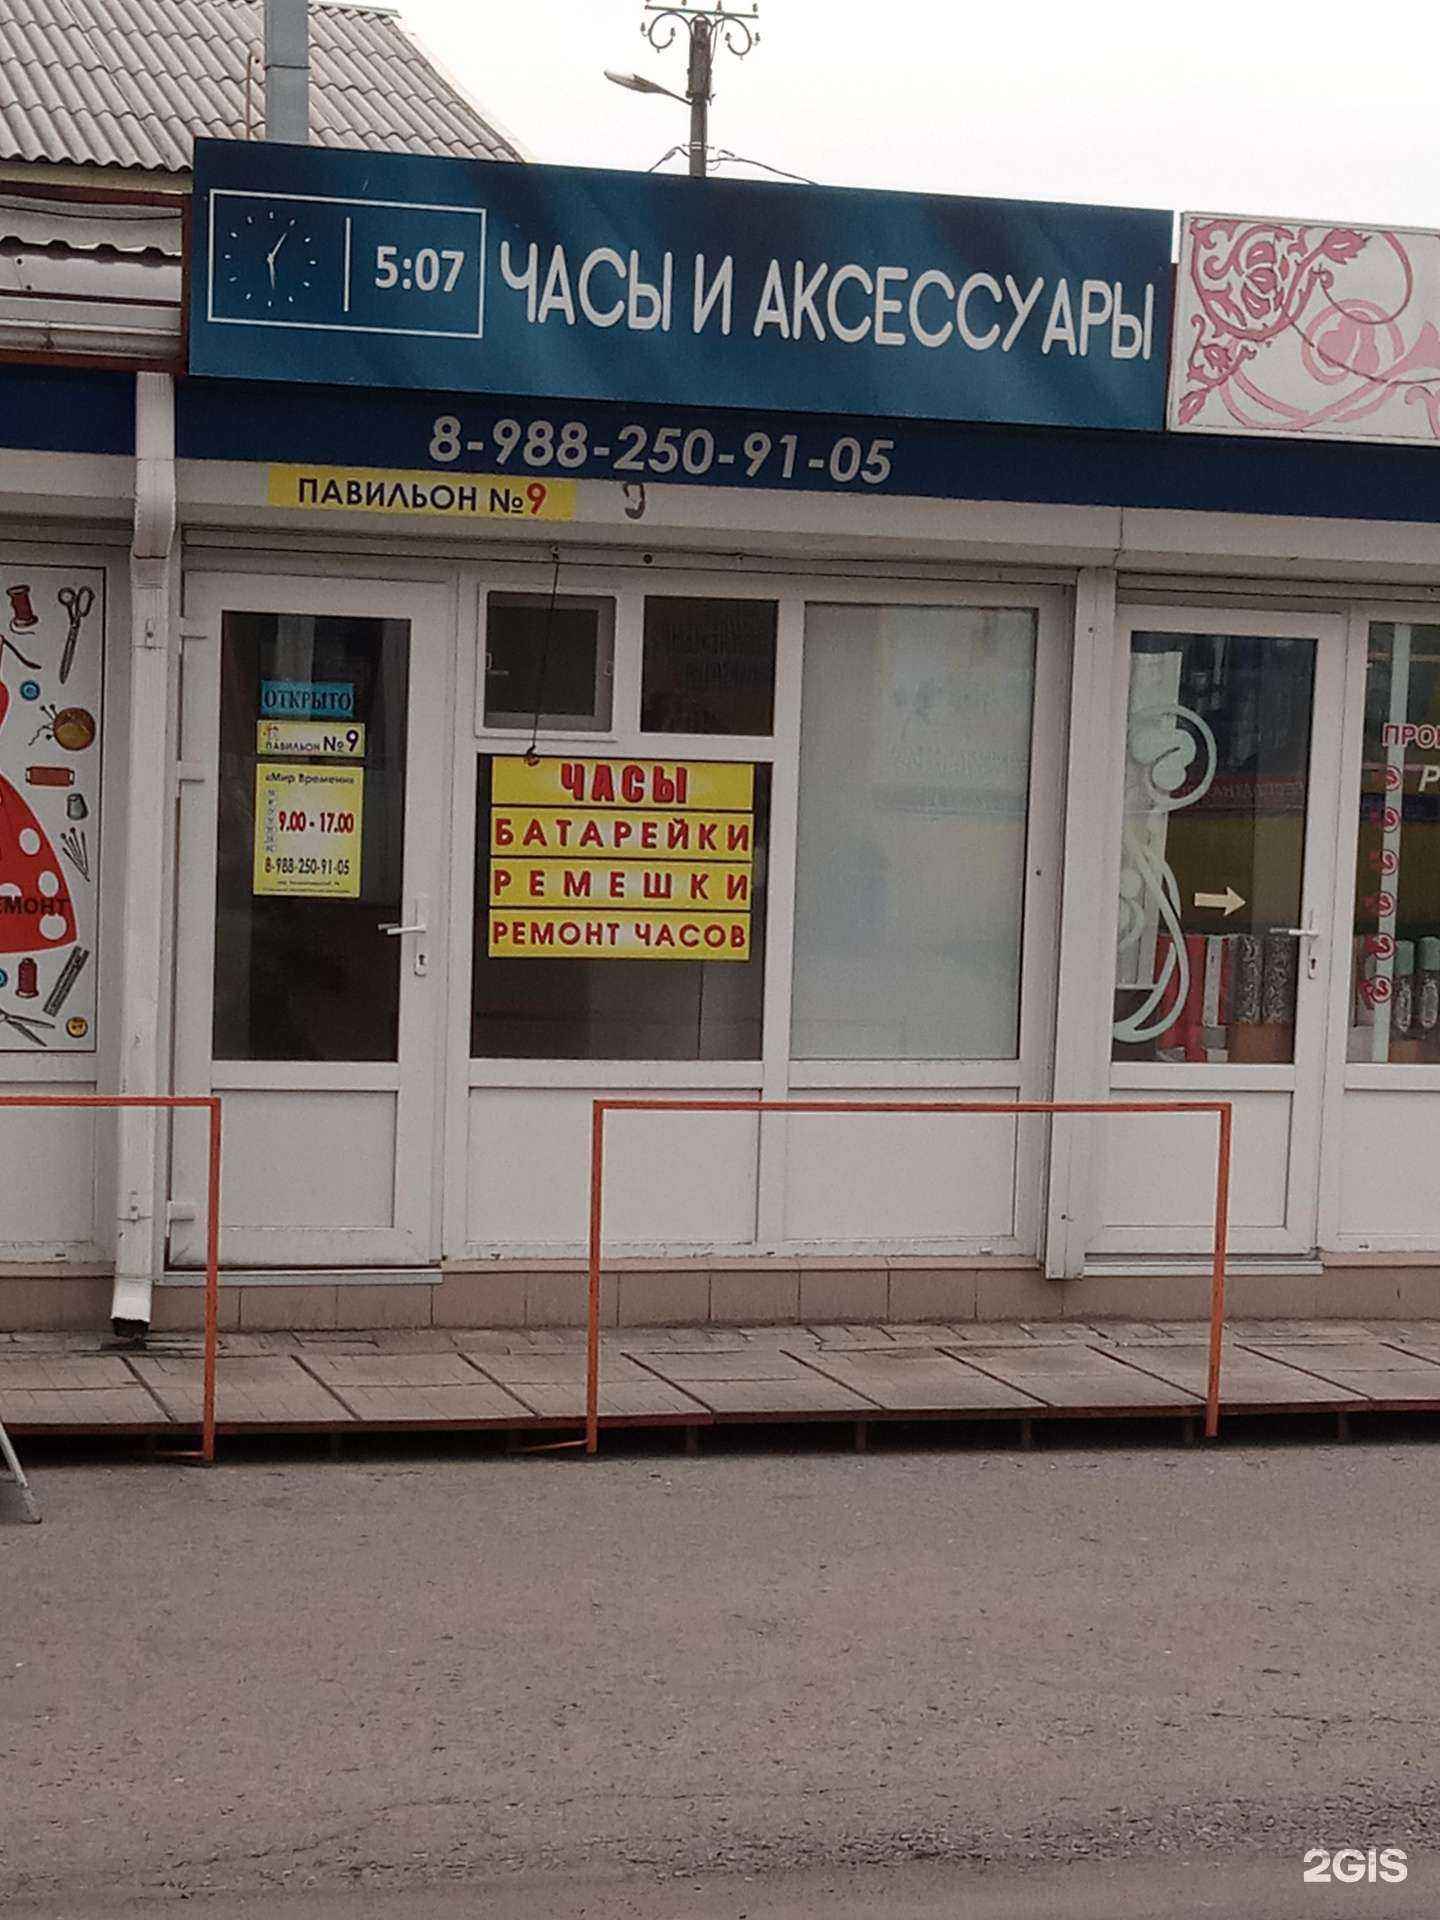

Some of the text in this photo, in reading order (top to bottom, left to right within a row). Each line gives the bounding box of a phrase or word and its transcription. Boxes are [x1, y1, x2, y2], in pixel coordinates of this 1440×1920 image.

[374, 245, 465, 293] 5:07
[500, 241, 1155, 361] ЧАСЫ И АКСЕССУАРЫ
[428, 415, 895, 484] 8-988-250-91-05
[298, 478, 478, 513] ПАВИЛЬОН
[264, 689, 352, 711] ОТКРЫТО
[265, 741, 320, 752] ПАВИЛЬОН
[1382, 722, 1440, 750] ПРО
[560, 763, 687, 805] ЧАСЫ
[278, 810, 306, 833] 9.00
[320, 811, 355, 834] 17.00
[494, 817, 749, 851] БАТАРЕЙКИ
[493, 869, 748, 901] РЕМЕШКИ
[0, 896, 71, 915] МОНТ
[492, 921, 746, 948] РЕМОНТ ЧАСОВ
